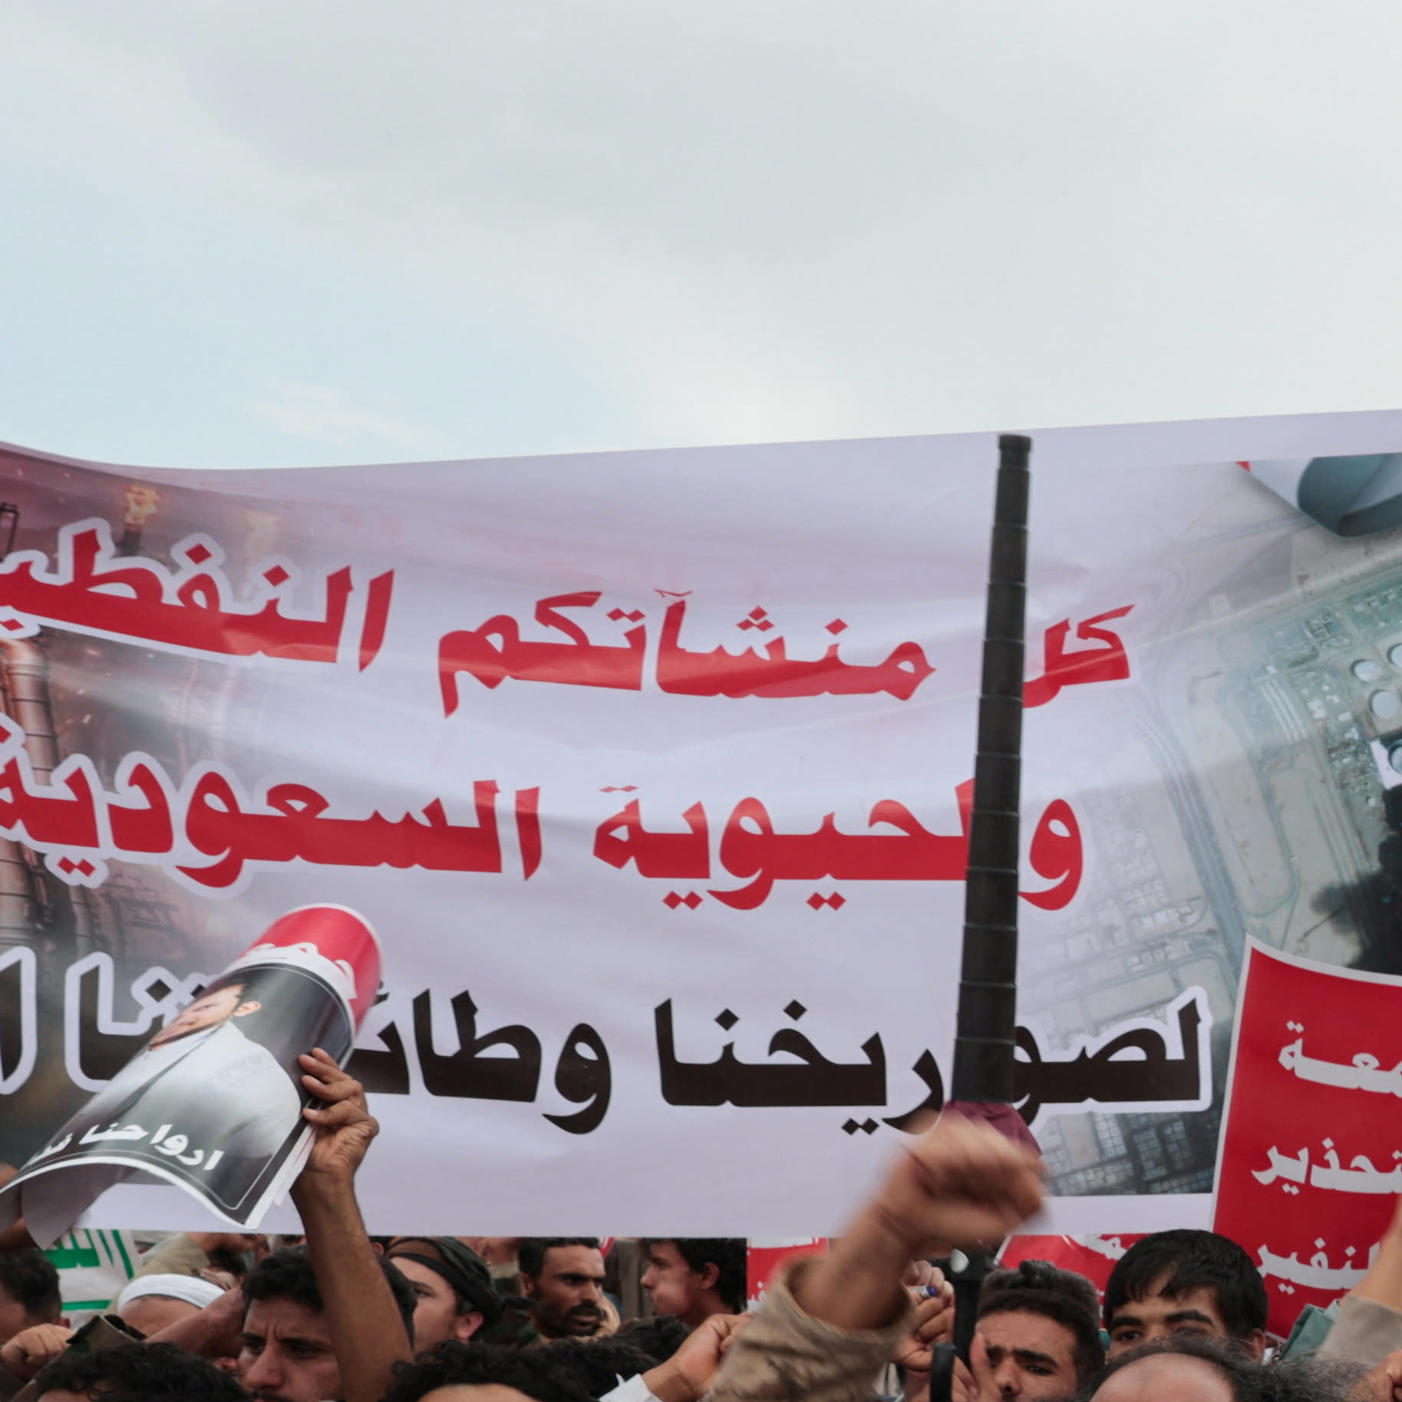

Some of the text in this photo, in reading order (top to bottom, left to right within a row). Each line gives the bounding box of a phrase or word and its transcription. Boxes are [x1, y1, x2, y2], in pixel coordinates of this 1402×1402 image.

[0, 527, 395, 674] النفطي
[593, 778, 1083, 912] ولحيوية
[1257, 1237, 1381, 1295] لنفير
